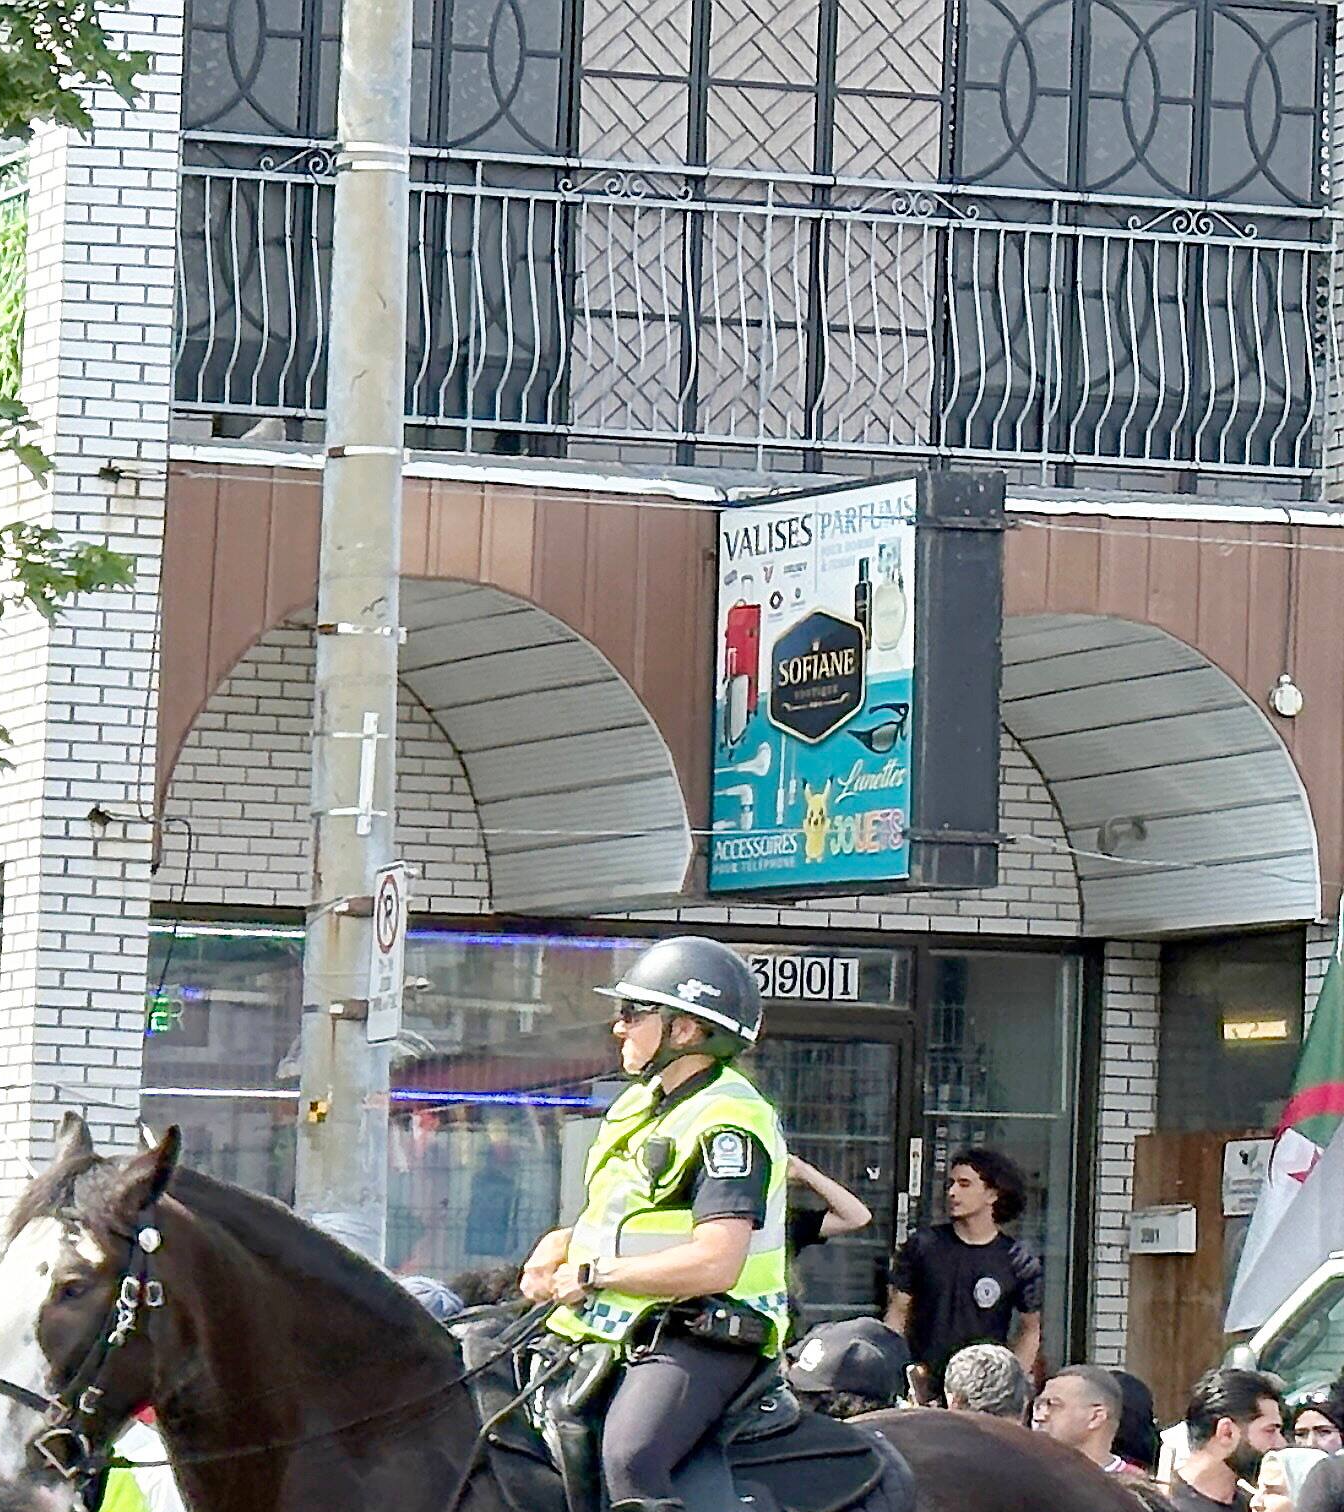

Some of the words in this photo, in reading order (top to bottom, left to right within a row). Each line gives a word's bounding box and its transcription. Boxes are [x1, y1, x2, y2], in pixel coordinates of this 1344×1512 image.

[723, 513, 813, 561] VALISES
[819, 495, 915, 540] PARFUMS
[778, 648, 855, 687] SOFIANE
[835, 757, 907, 804] Lunettes
[715, 832, 798, 861] ACCESSOIRES
[830, 808, 905, 855] JOUETS
[752, 958, 851, 995] 3901
